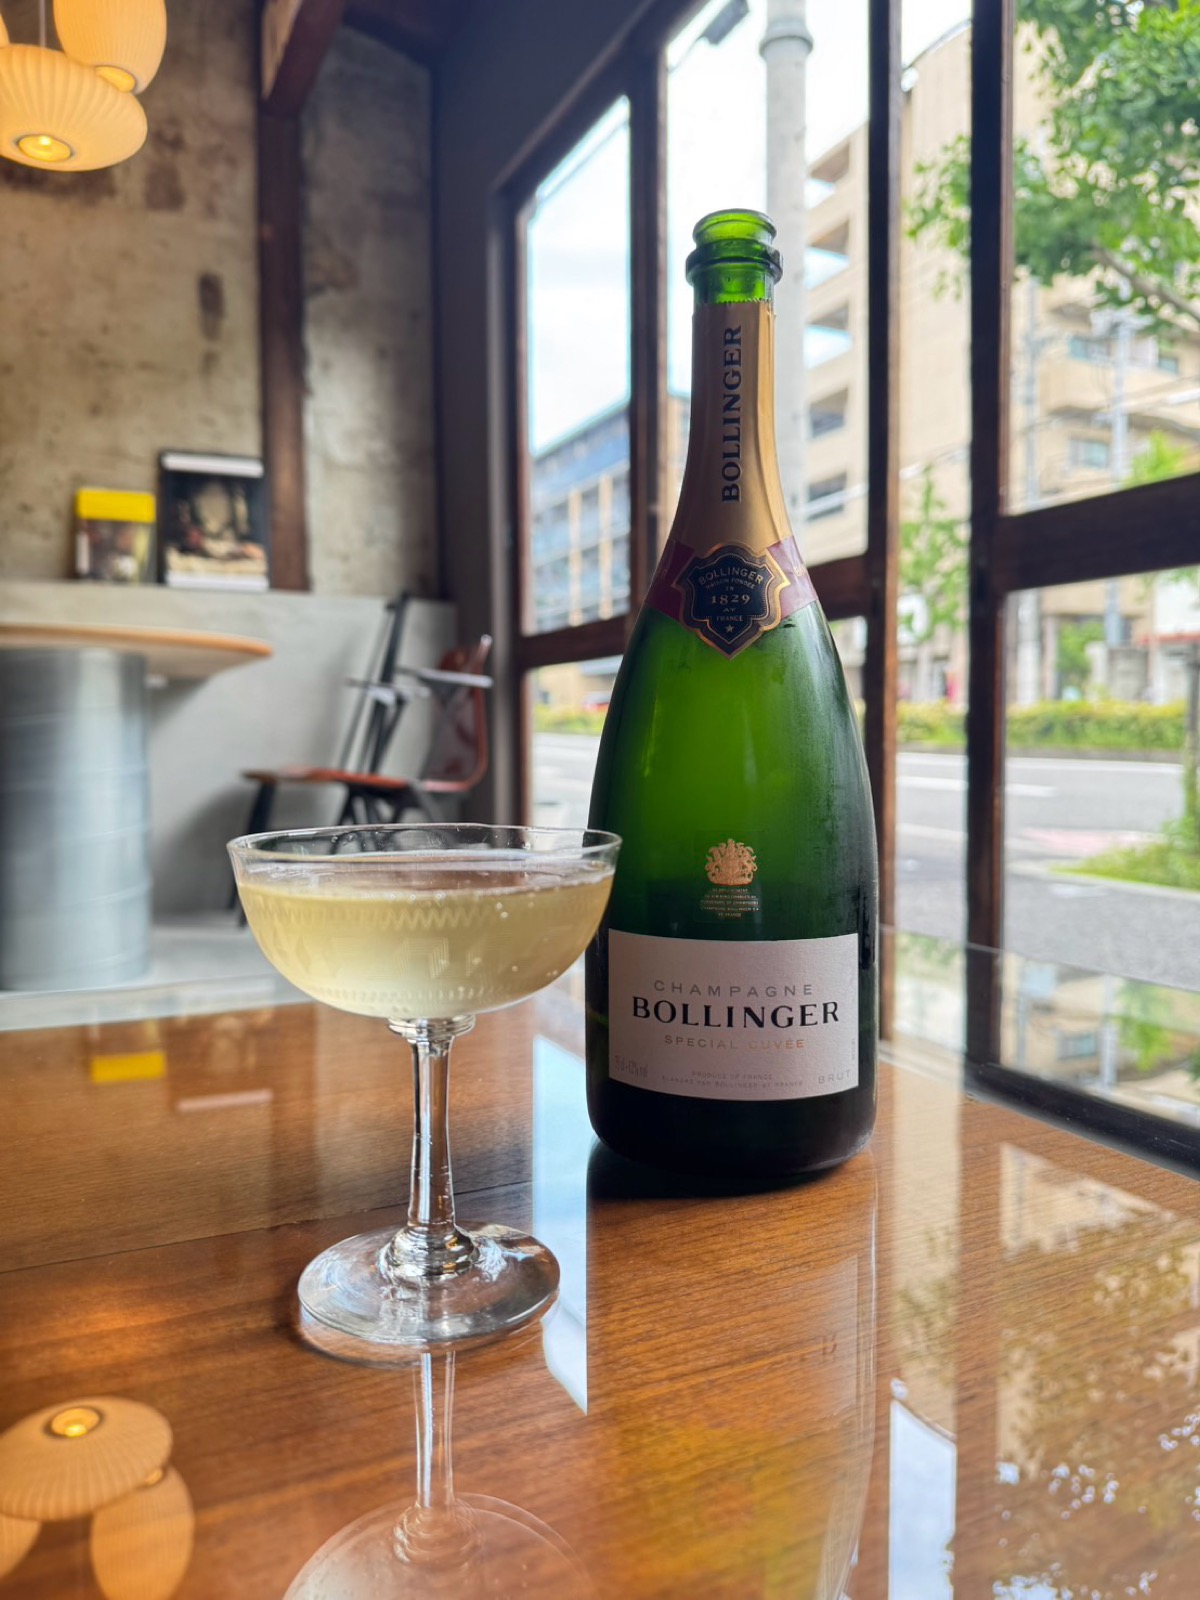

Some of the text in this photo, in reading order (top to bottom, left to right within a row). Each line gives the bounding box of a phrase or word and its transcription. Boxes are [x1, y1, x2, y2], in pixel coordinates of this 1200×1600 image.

[721, 325, 742, 502] BOLLINGER
[698, 566, 764, 585] BOLLINGER
[711, 594, 751, 606] 1829
[716, 614, 744, 622] FRANCE
[654, 979, 814, 998] CHAMPAGNE
[632, 996, 839, 1029] BOLLINGER
[664, 1034, 805, 1050] SPECIAL CUVÉE
[691, 1070, 727, 1080] PRODUCE
[743, 1073, 773, 1081] FRANCE
[817, 1068, 851, 1085] BRUT
